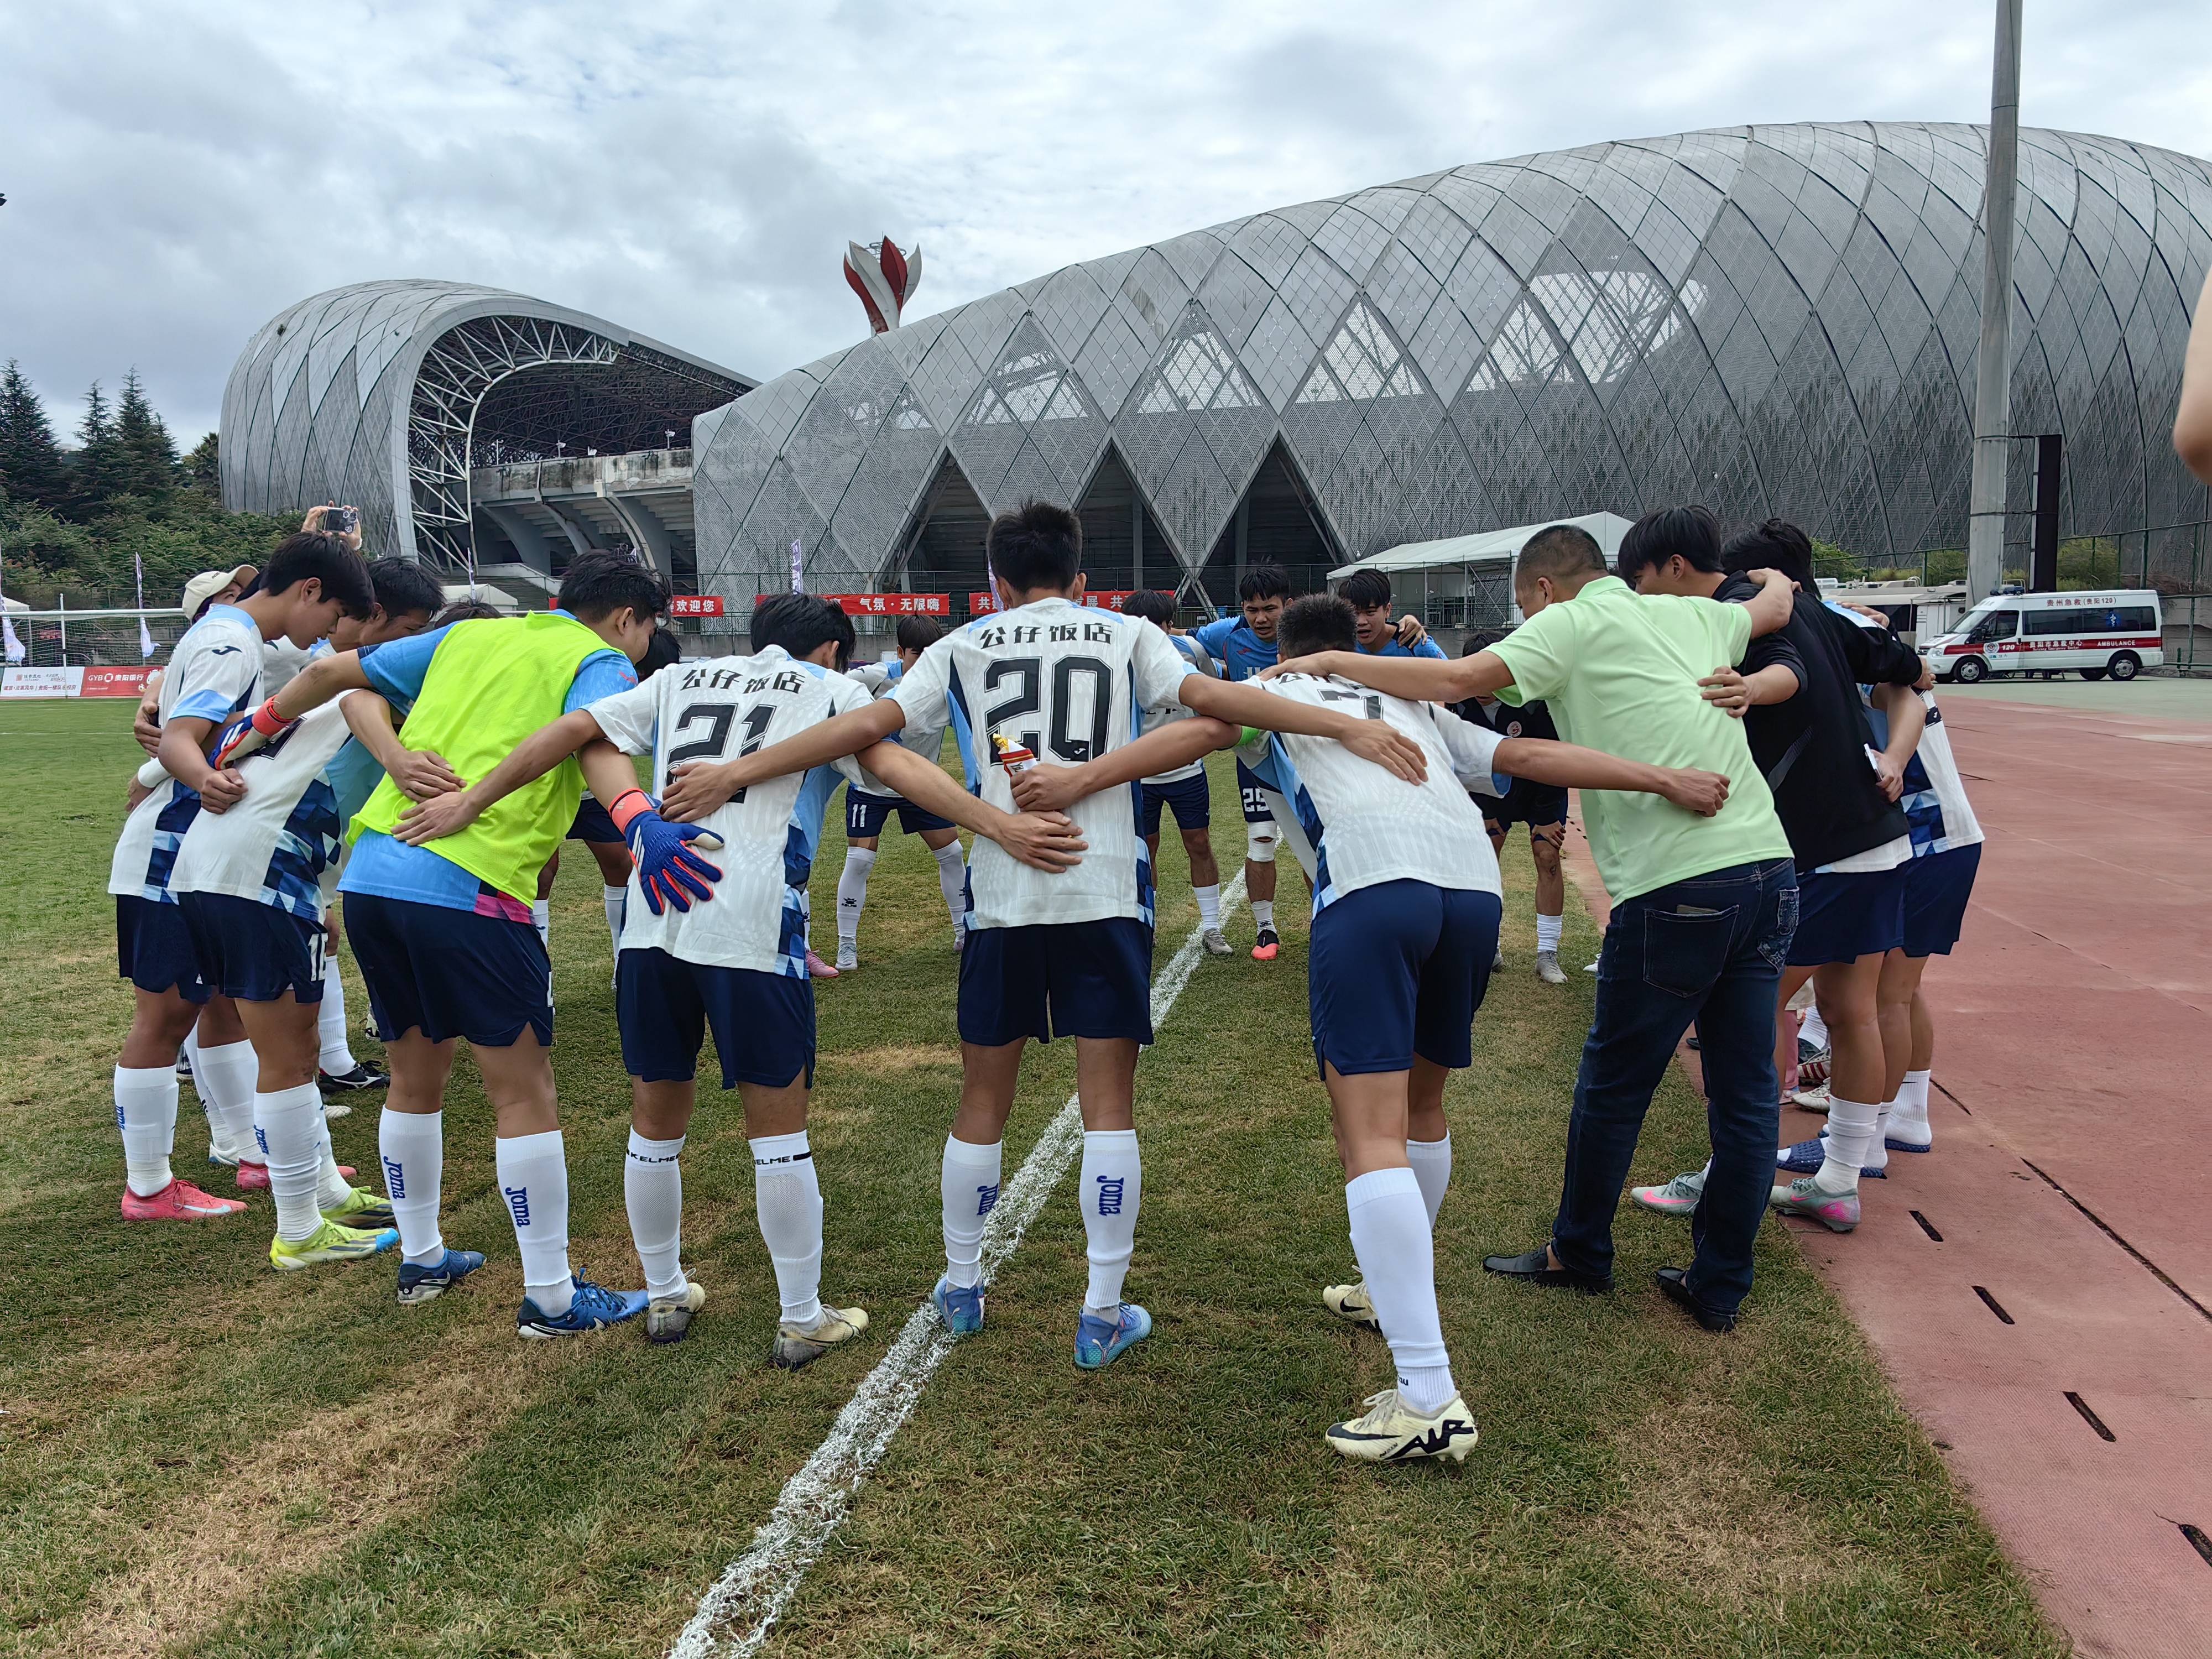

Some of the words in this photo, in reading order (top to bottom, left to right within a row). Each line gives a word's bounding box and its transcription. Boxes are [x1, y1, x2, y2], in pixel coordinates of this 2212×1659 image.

[979, 623, 1113, 650] 公仔饭店
[680, 668, 806, 694] 公仔饭店
[984, 654, 1114, 767] 20
[665, 703, 778, 804] 21
[852, 804, 867, 827] 11
[630, 1152, 676, 1163] KELME
[754, 1156, 791, 1165] ELME
[383, 1155, 406, 1199] Joma
[505, 1186, 531, 1228] Joma
[976, 1182, 999, 1216] Joma
[1096, 1175, 1124, 1217] Joma
